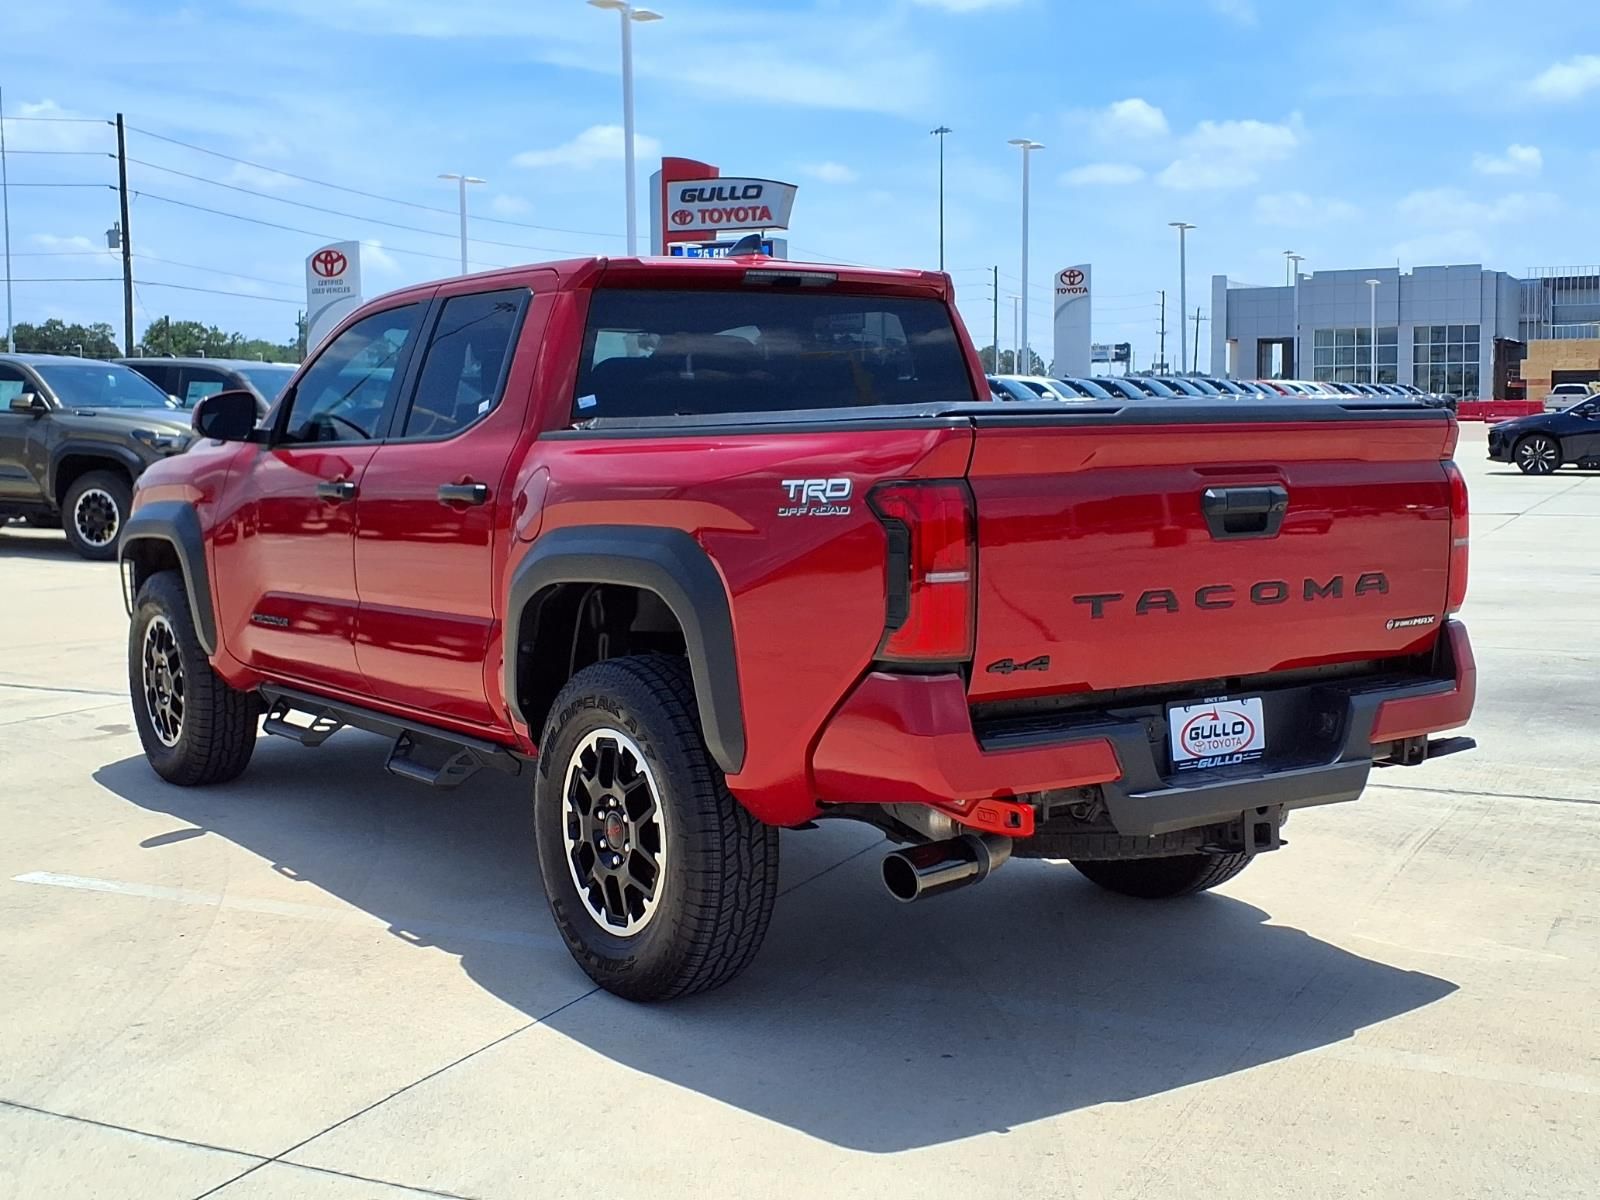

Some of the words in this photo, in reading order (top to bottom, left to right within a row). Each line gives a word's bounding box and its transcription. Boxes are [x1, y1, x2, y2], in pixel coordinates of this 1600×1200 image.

[680, 184, 763, 203] GULLO
[698, 206, 772, 224] TOYOTA
[326, 286, 351, 294] VEHICLES
[781, 478, 852, 504] TRD
[777, 507, 808, 516] OFF
[809, 506, 851, 516] ROAD
[1072, 572, 1391, 619] TACOMA
[1189, 721, 1245, 741] GULLO
[1207, 737, 1242, 750] TOYOTA
[1197, 754, 1243, 769] GULLO
